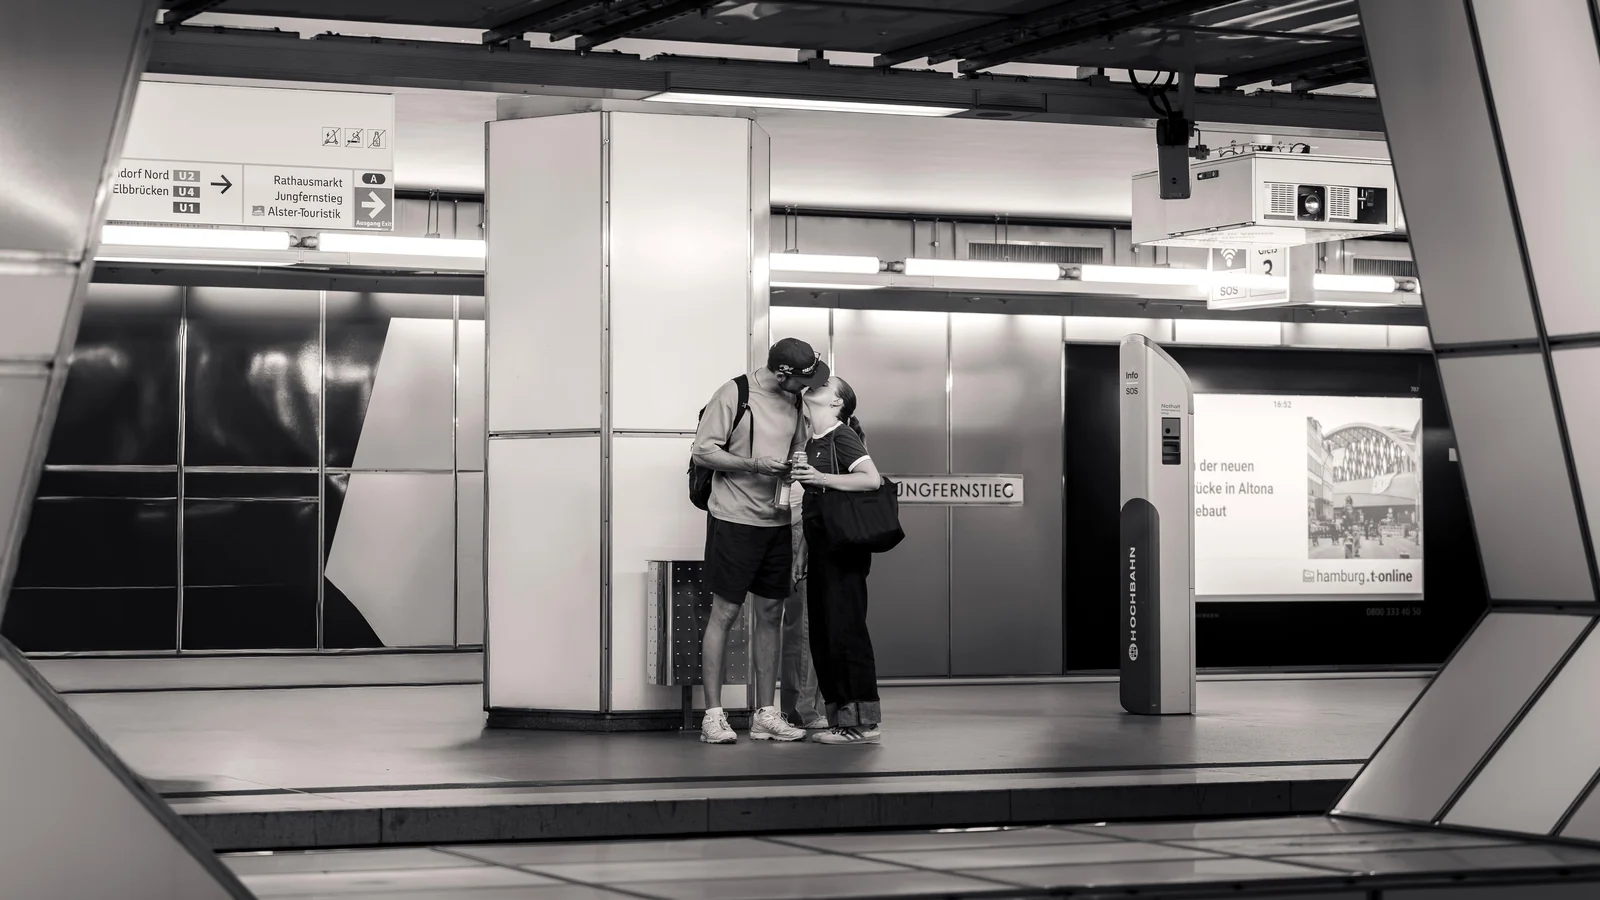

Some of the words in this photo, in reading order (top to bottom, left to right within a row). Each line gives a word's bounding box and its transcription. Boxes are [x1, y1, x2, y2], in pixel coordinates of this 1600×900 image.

[144, 169, 170, 180] Nord
[179, 171, 195, 181] U2
[273, 175, 343, 188] Rathausmarkt
[370, 174, 378, 184] A
[112, 183, 169, 196] Elbbrücken
[178, 187, 195, 197] U4
[274, 191, 343, 206] Jungfernstieg
[179, 203, 194, 213] U1
[267, 206, 341, 219] Alster-Touristik
[1220, 286, 1239, 296] SOS
[1125, 371, 1139, 379] Info
[1125, 387, 1139, 395] SOS
[1273, 400, 1292, 409] 16:52
[1199, 459, 1218, 472] der
[1221, 461, 1254, 472] neuen
[896, 483, 1013, 498] UNGFERNSTIEG
[1194, 481, 1222, 495] ücke
[1225, 481, 1235, 495] in
[1238, 481, 1274, 495] Altona
[1194, 503, 1227, 517] ebaut
[1316, 569, 1413, 585] hamburg.t-online
[1366, 607, 1385, 616] 0800
[1386, 607, 1400, 616] 333
[1401, 607, 1411, 616] 40
[1412, 607, 1422, 616] 50
